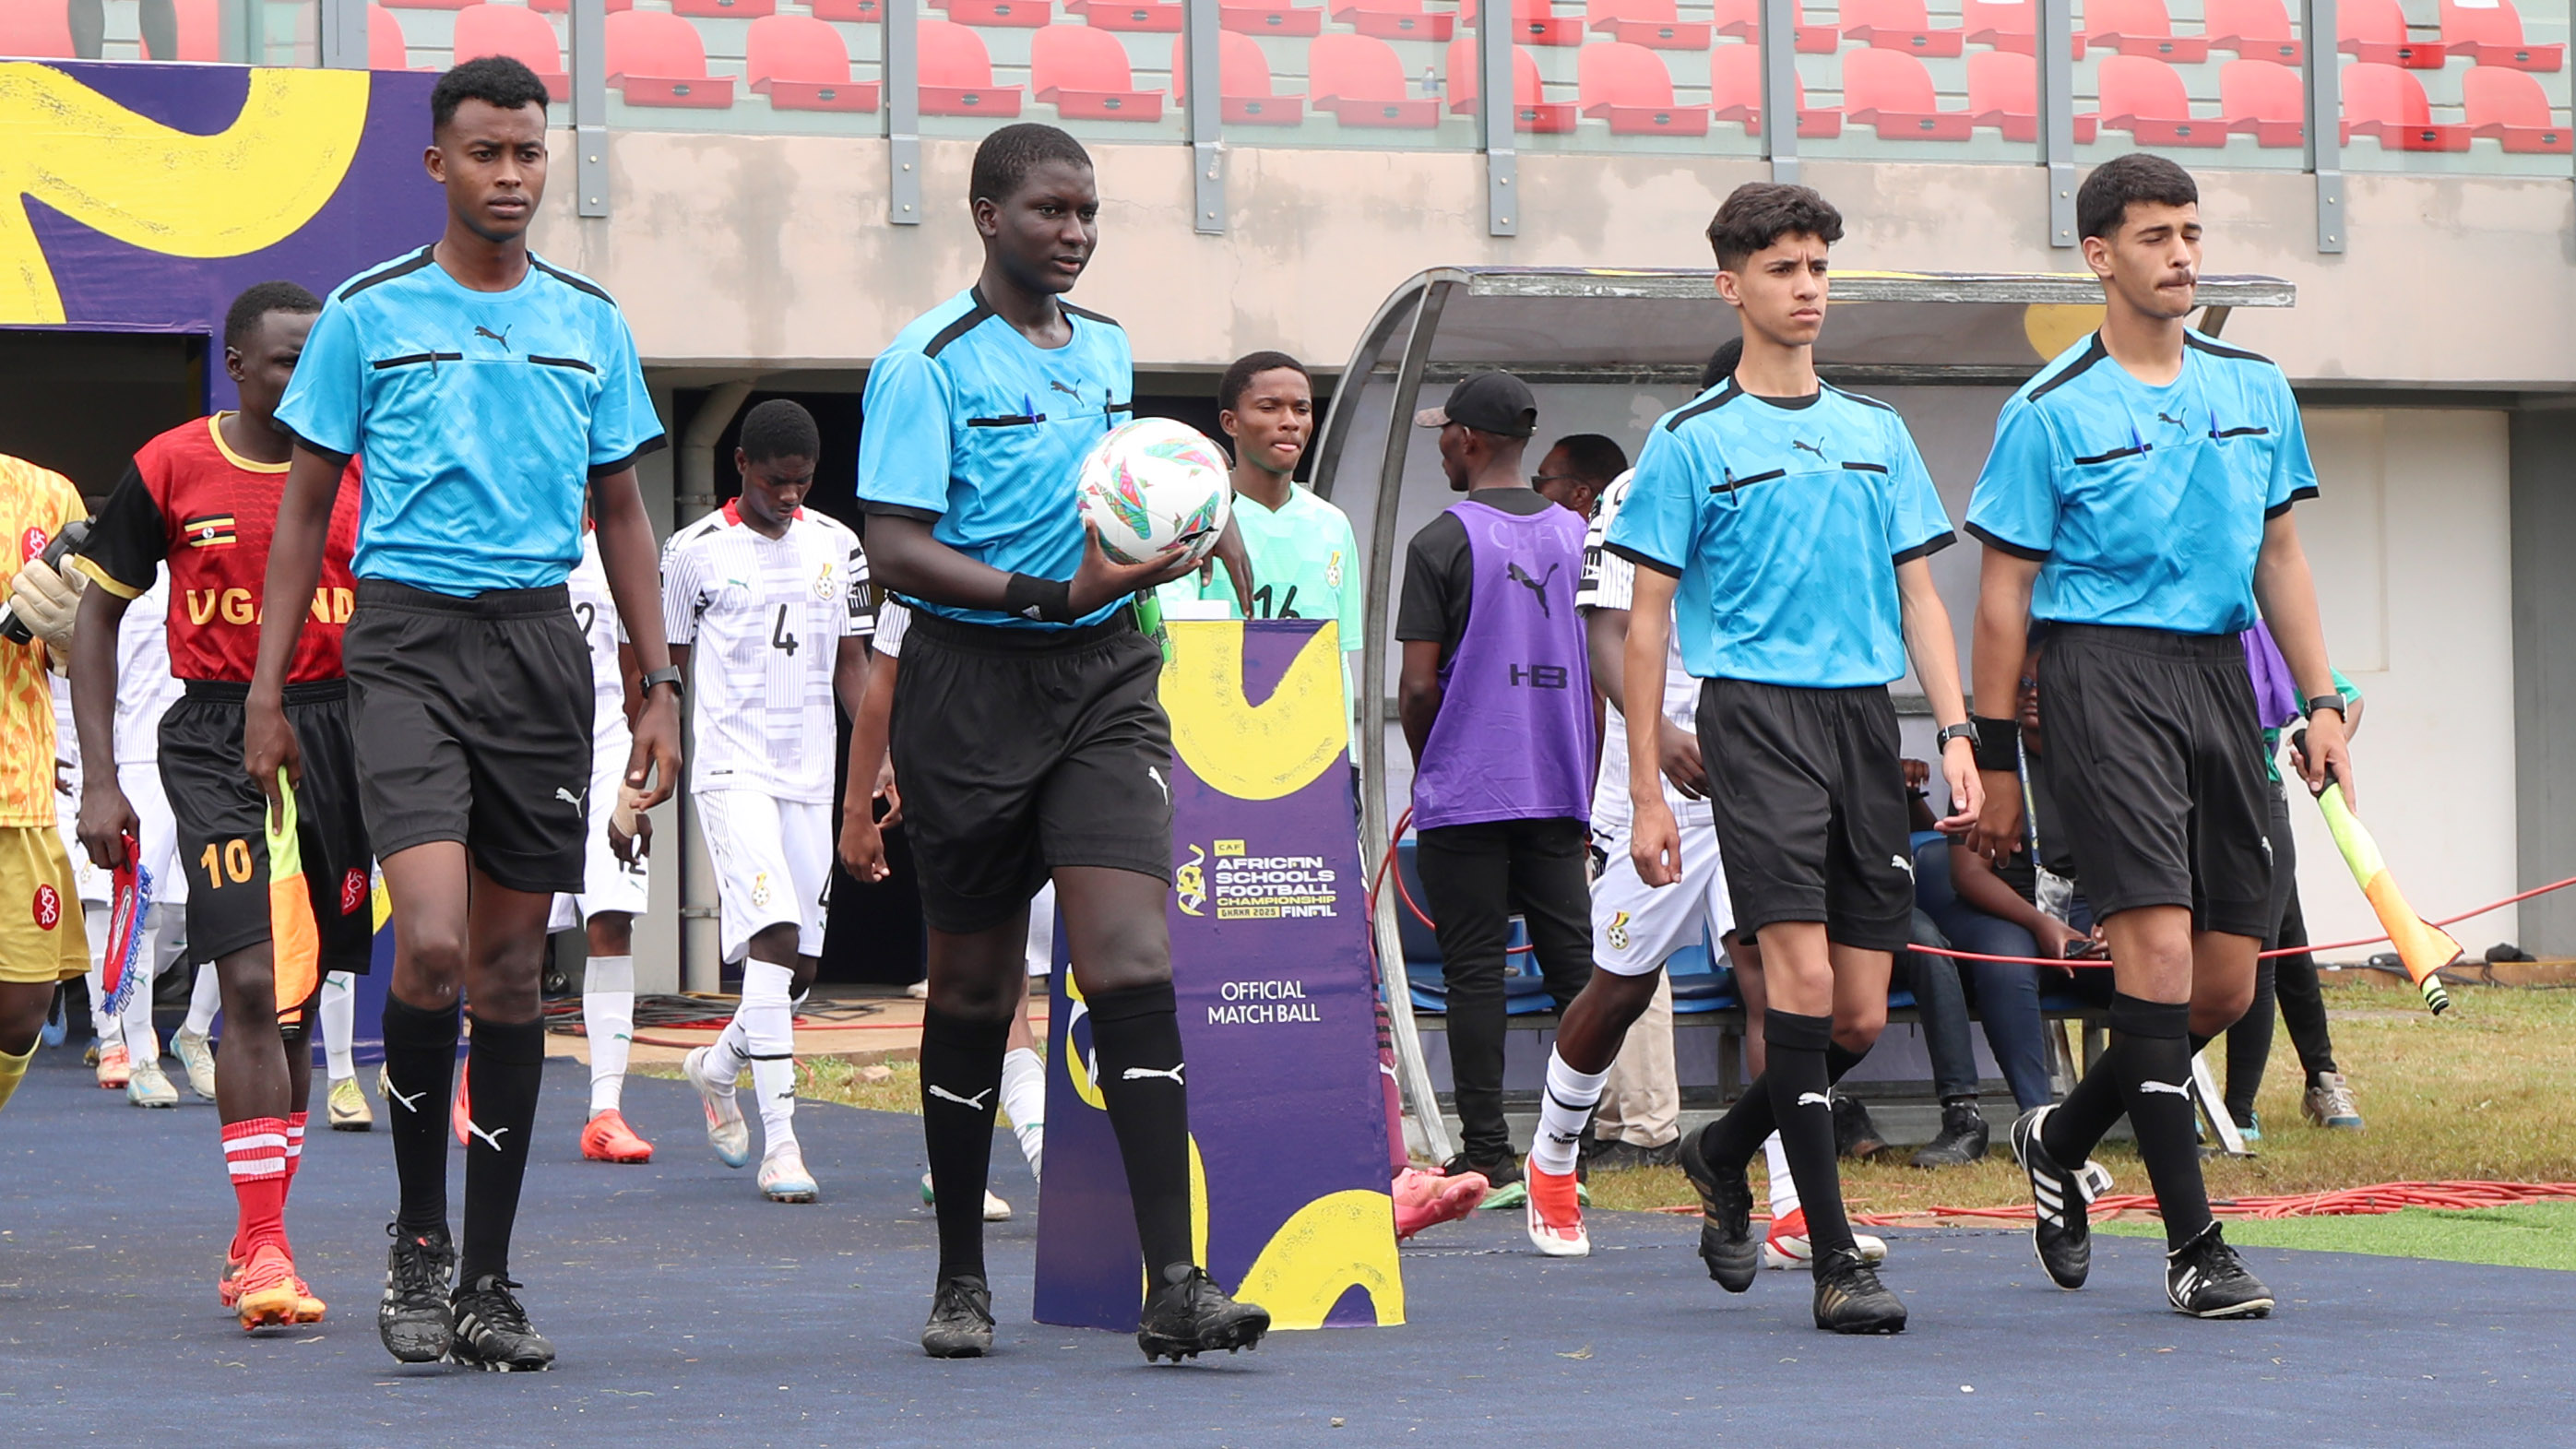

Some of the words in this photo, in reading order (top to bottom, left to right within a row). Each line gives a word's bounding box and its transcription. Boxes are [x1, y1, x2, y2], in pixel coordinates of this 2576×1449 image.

[186, 588, 355, 625] UGND
[1253, 584, 1300, 619] 16
[772, 603, 799, 657] 4
[1510, 663, 1568, 689] HB
[1217, 843, 1241, 851] CAF
[200, 838, 254, 889] 10
[1215, 857, 1324, 870] AFRICAN
[1215, 870, 1336, 885] SCHOOLS
[1216, 884, 1337, 897] FOOTBALL
[1217, 896, 1337, 907] CHAMPIONSHIP
[1221, 908, 1251, 918] GHANA
[1252, 908, 1276, 917] 2025
[1280, 905, 1337, 918] FINAL
[1220, 980, 1306, 1002] OFFICIAL
[1207, 1004, 1273, 1025] MATCH
[1276, 1003, 1321, 1023] BALL
